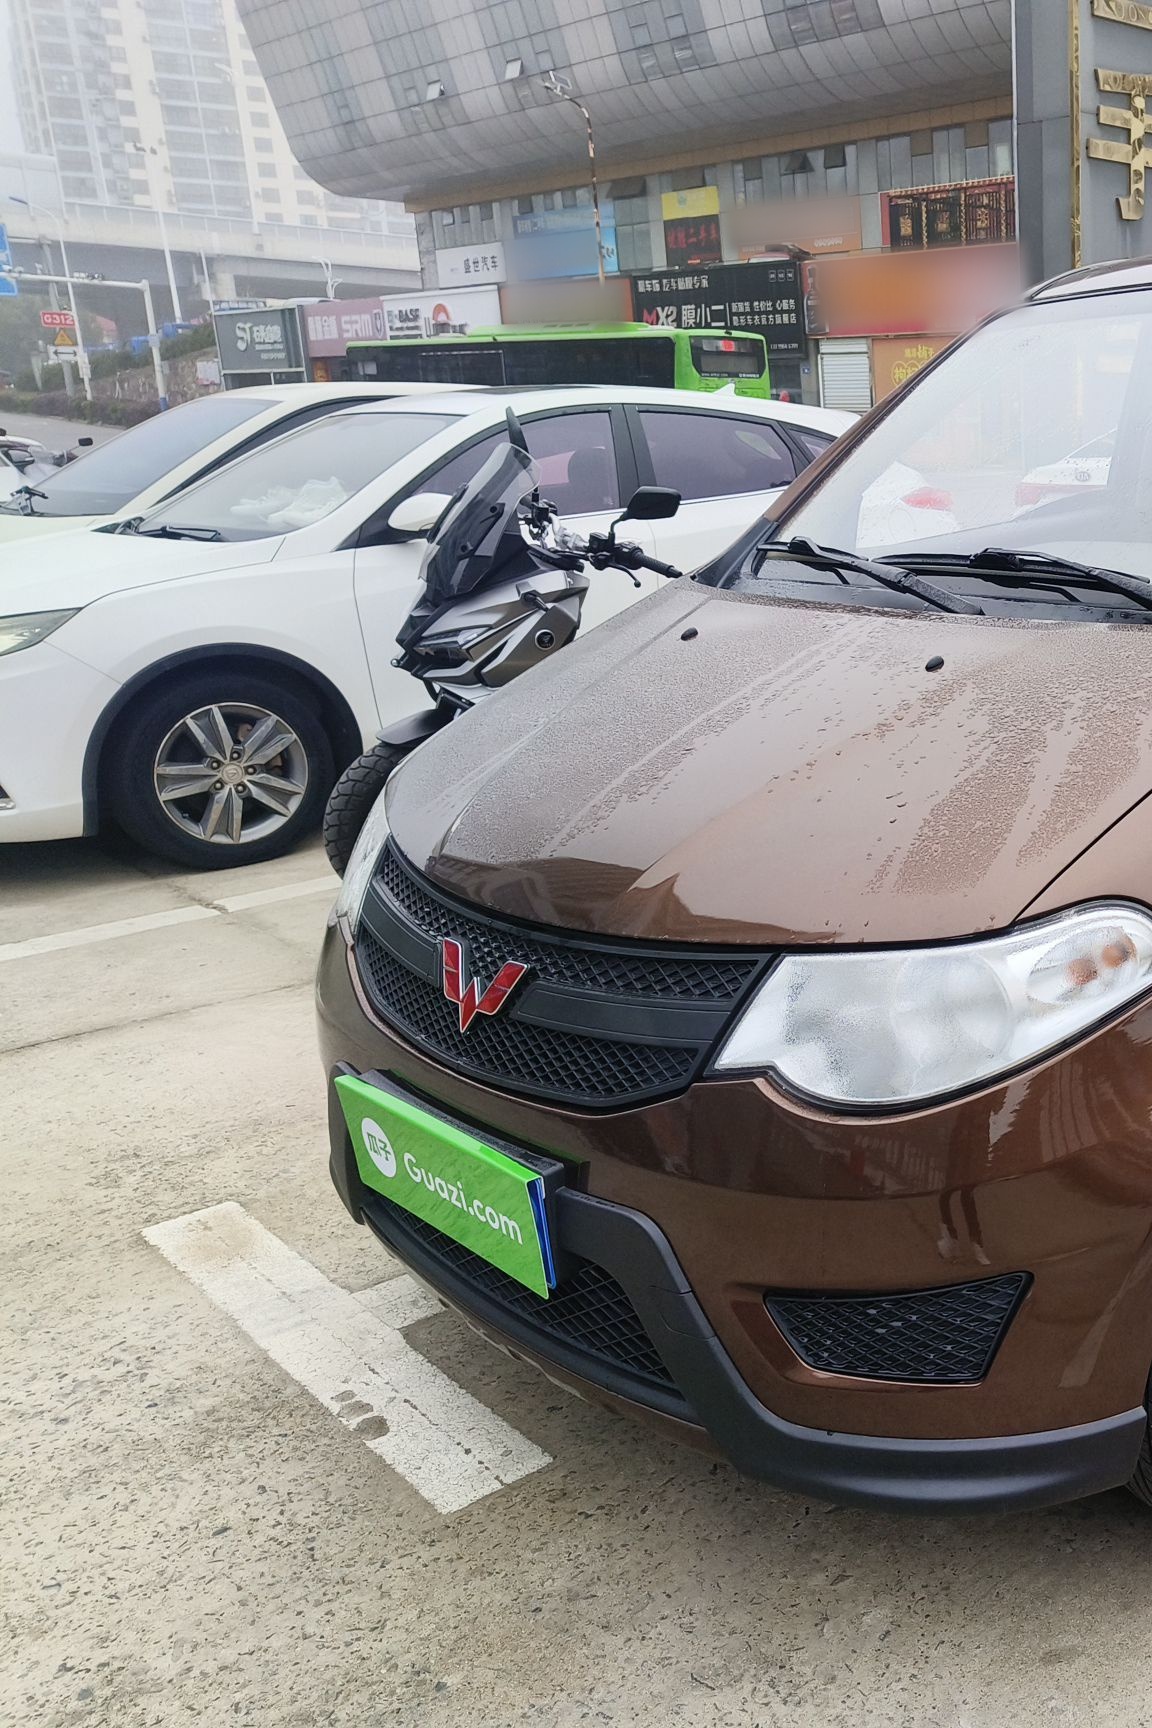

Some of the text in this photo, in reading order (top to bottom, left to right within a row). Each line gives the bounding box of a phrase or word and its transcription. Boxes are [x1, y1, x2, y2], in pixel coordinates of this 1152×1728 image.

[463, 255, 499, 274] 盛世汽车
[43, 313, 74, 325] G312
[341, 313, 373, 338] SRM
[642, 303, 726, 328] MX2 膜小二
[366, 1130, 392, 1163] 瓜子
[402, 1151, 525, 1246] Guazi.com
